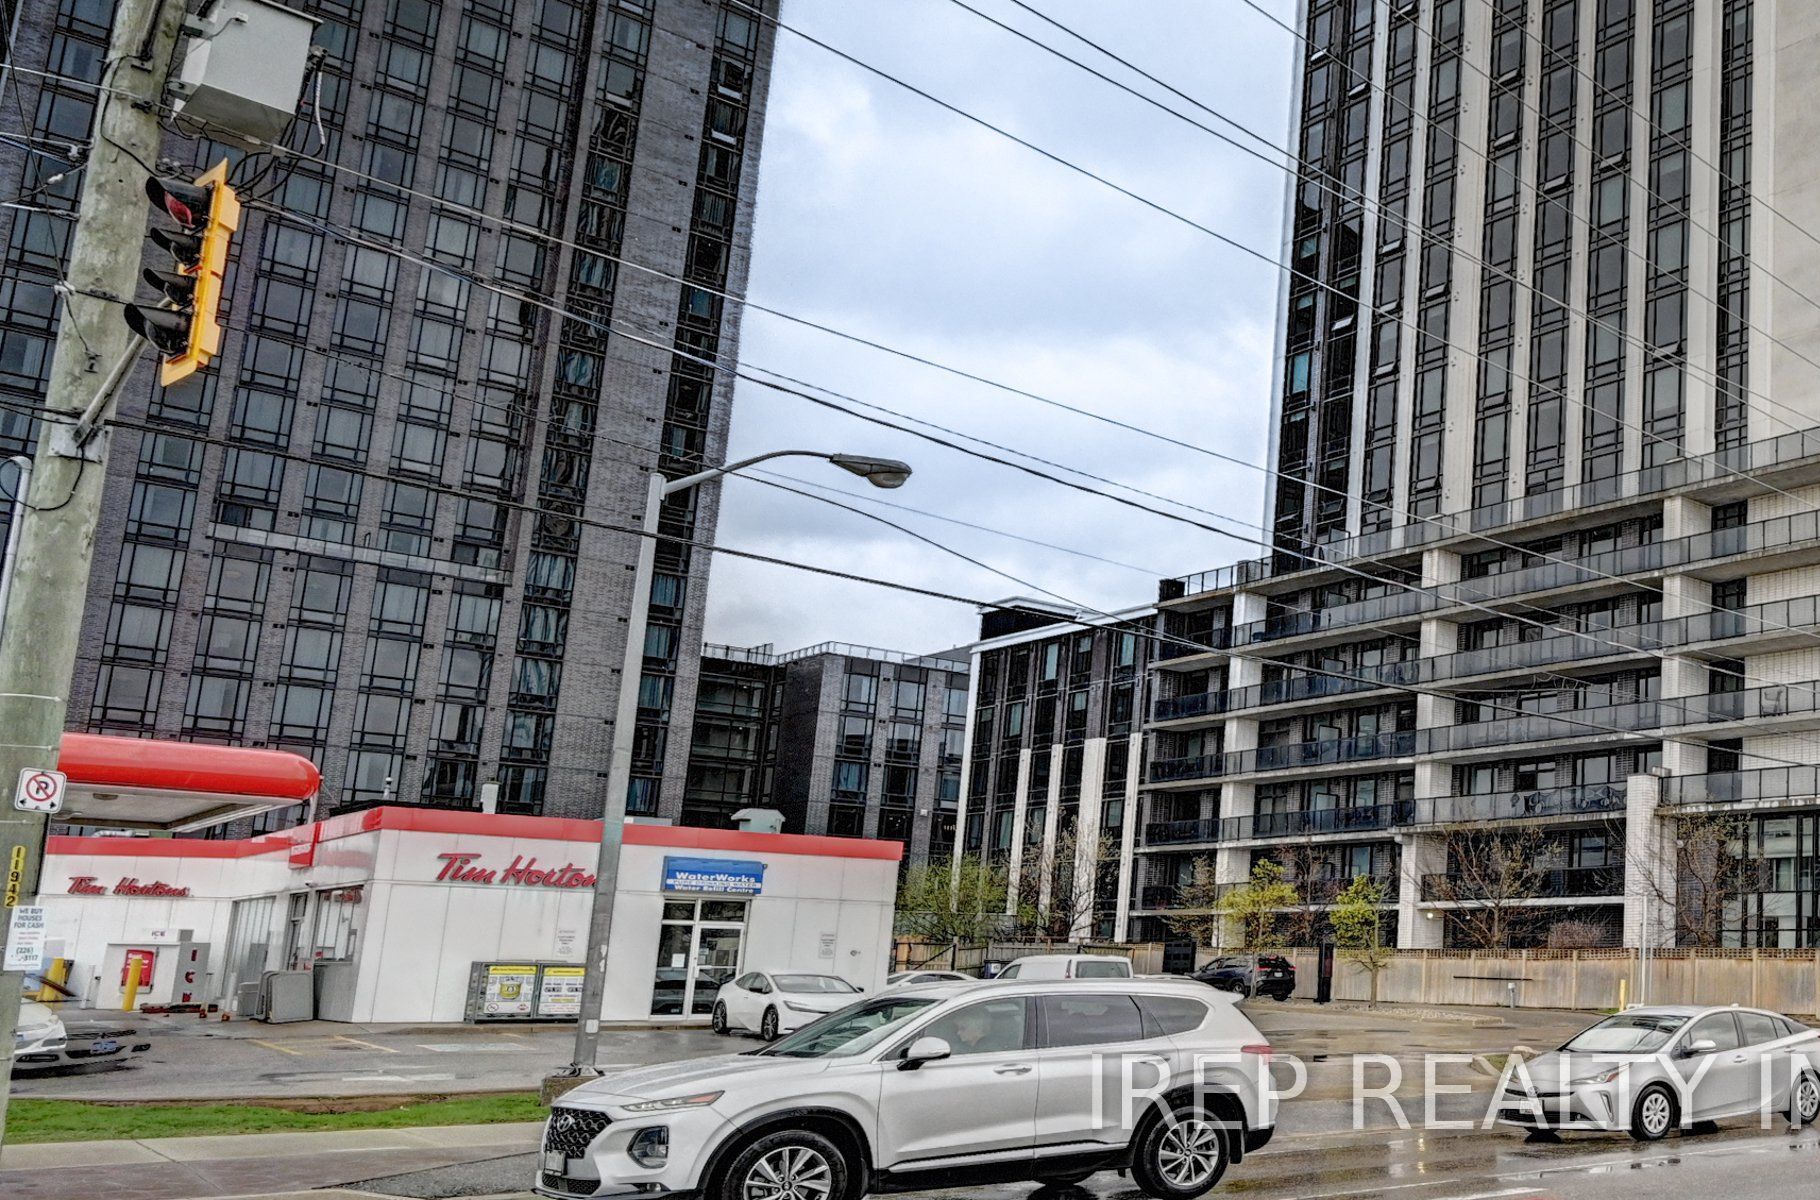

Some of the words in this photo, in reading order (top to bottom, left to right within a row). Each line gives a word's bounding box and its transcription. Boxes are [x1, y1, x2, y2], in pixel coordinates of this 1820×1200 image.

[436, 853, 497, 885] Tim
[501, 855, 598, 888] Horton
[675, 872, 756, 883] WaterWorks
[67, 876, 107, 895] Tim
[112, 877, 190, 897] Hortons
